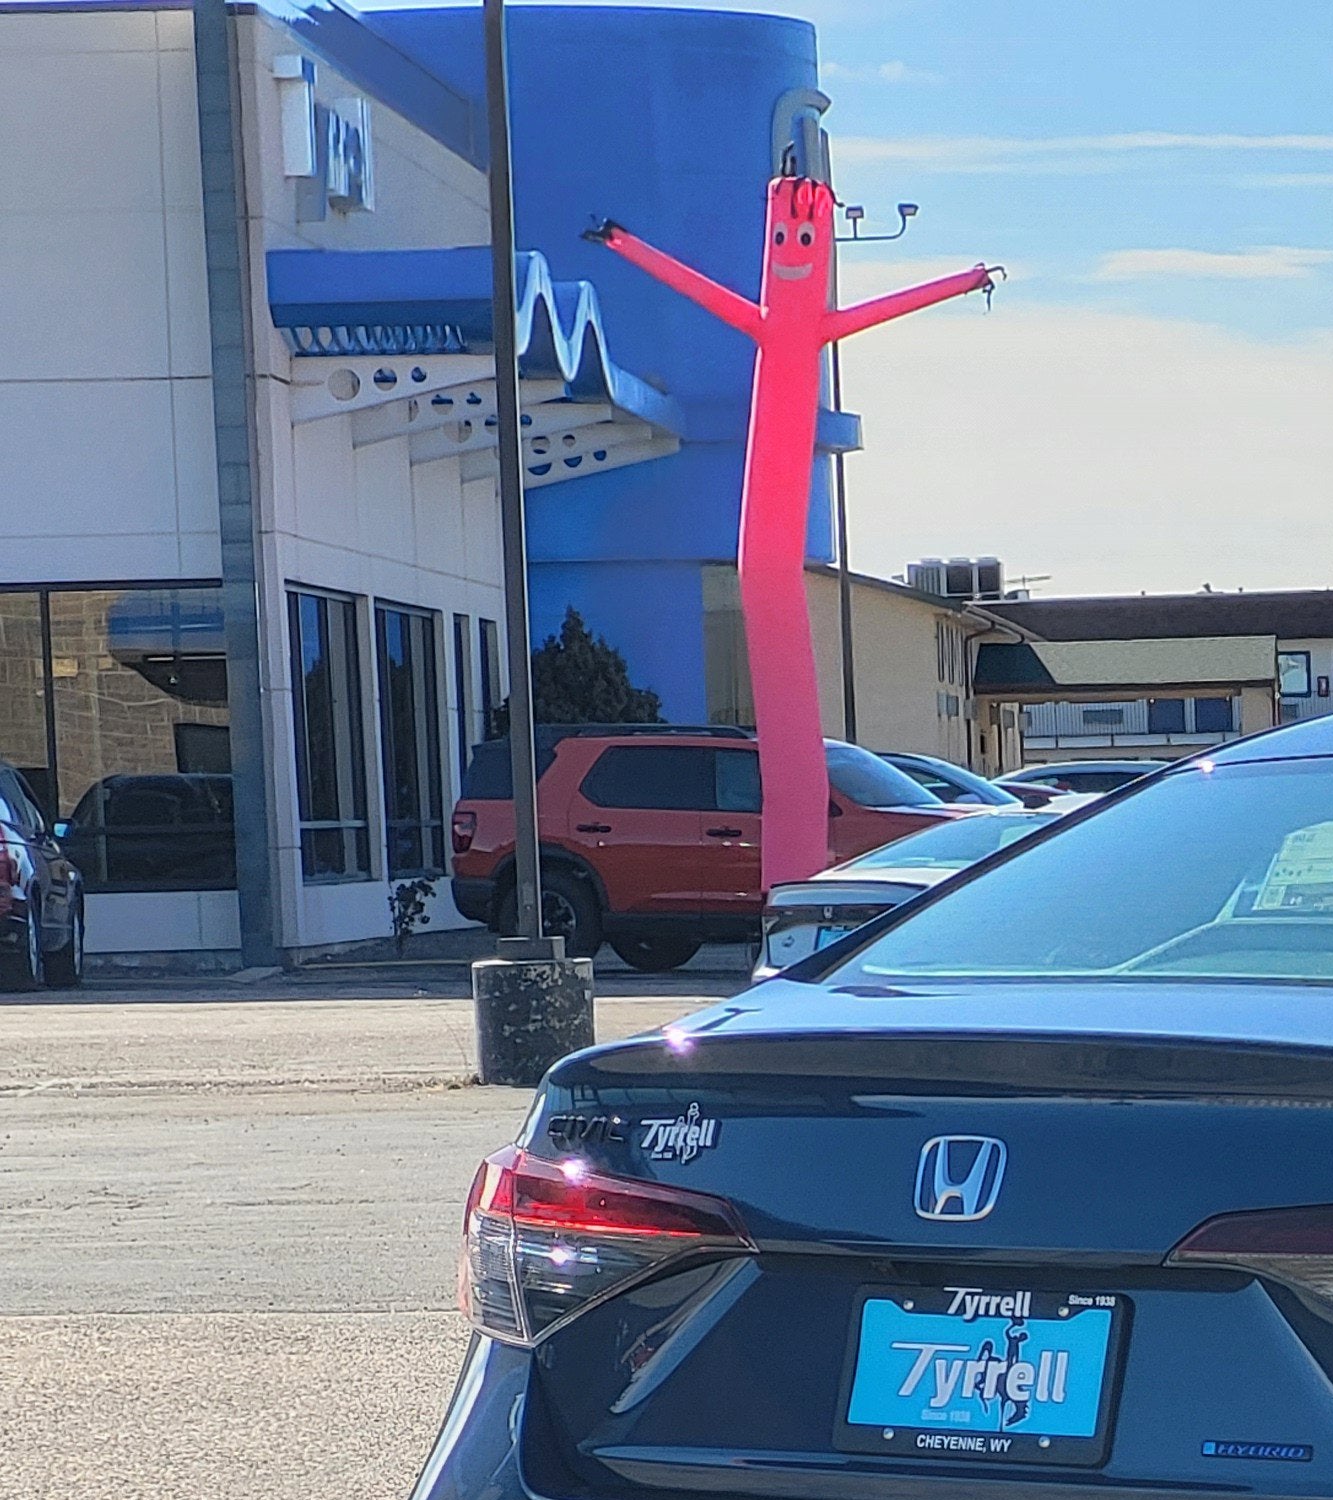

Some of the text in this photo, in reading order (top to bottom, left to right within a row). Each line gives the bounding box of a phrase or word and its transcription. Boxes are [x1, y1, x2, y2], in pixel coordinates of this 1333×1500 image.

[640, 1118, 717, 1152] Tyrrell
[943, 1287, 1032, 1320] Tyrrell
[891, 1342, 1068, 1408] Tyrrell
[916, 1434, 1012, 1453] CHEYENNE, WY
